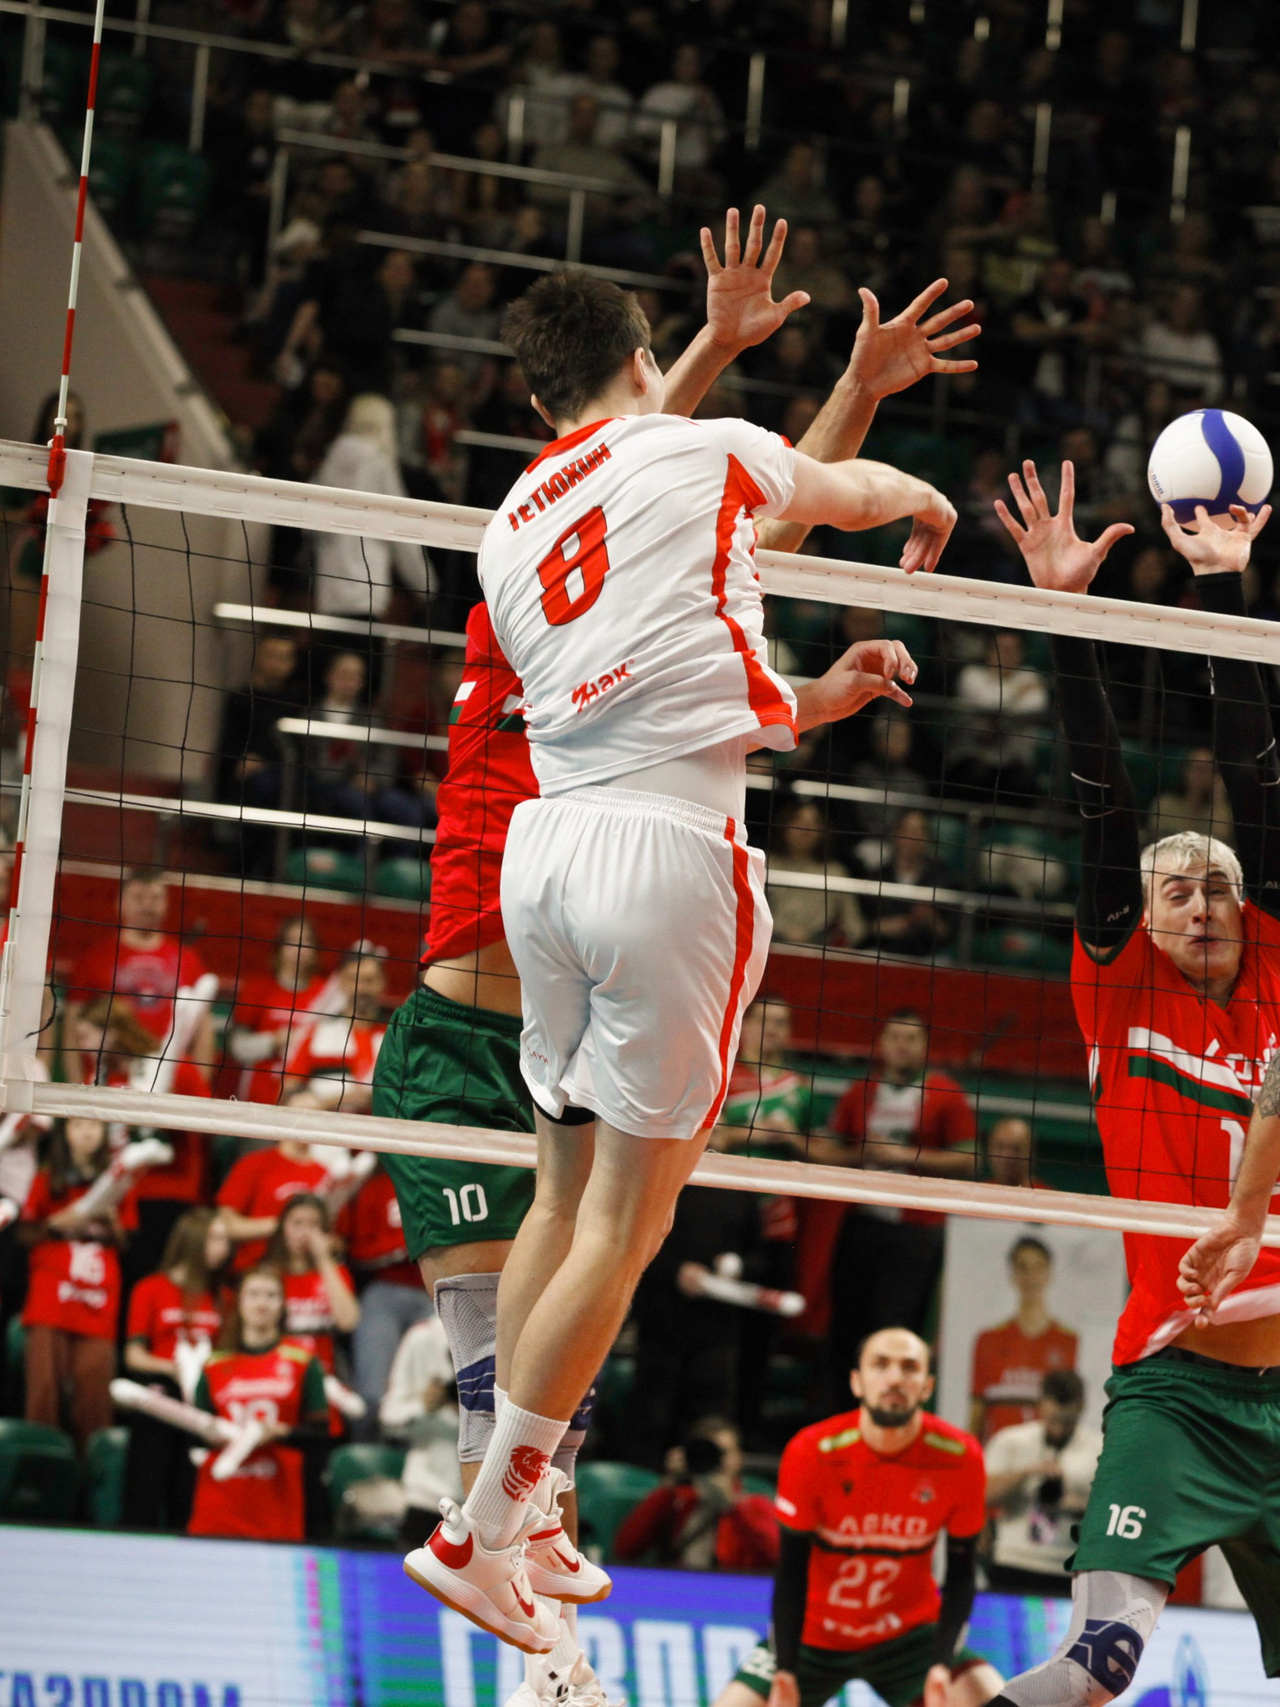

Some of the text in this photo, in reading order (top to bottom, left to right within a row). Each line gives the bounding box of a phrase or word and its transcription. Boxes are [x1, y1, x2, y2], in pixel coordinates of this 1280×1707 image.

[536, 505, 611, 626] 8
[442, 1183, 489, 1225] 10
[1106, 1503, 1147, 1540] 16
[827, 1558, 901, 1609] 22
